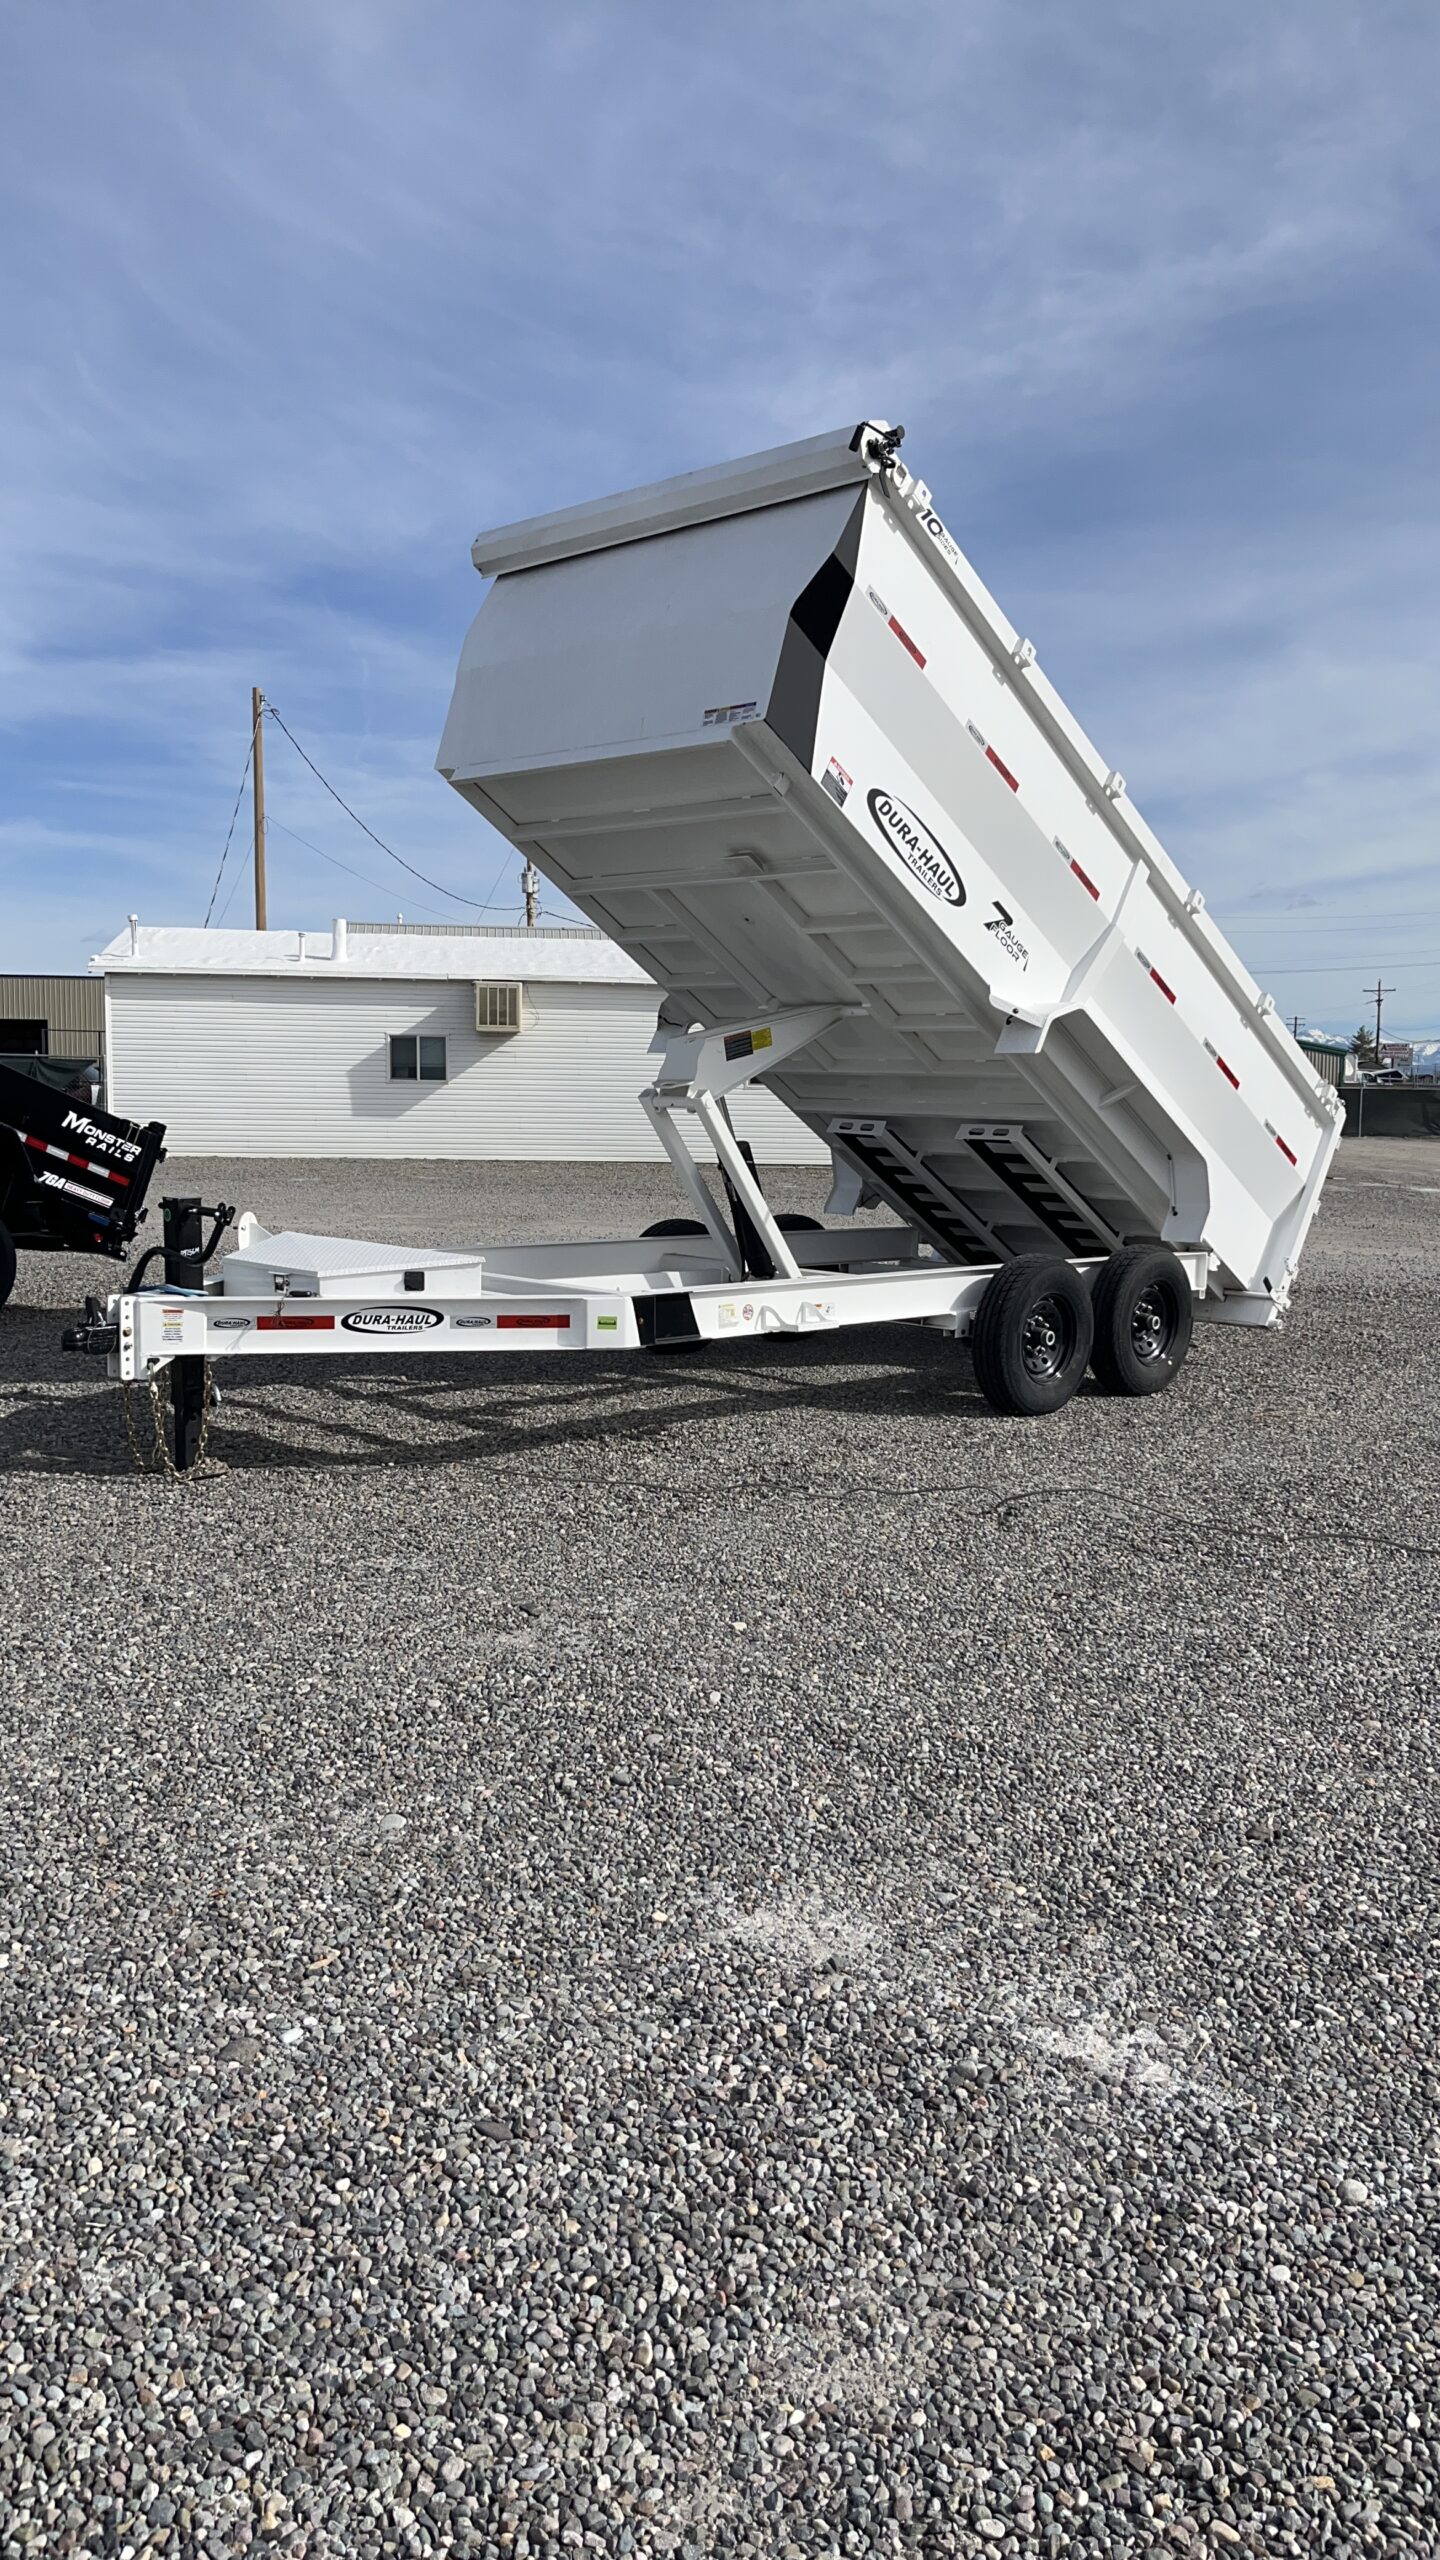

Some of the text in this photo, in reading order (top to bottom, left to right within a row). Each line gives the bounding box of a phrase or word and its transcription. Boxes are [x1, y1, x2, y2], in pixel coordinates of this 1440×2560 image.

[921, 508, 943, 536] 10
[877, 799, 955, 898] DURA-HAUL
[907, 851, 943, 897] TRAILERS
[983, 900, 1013, 931] 7
[989, 922, 1020, 962] FLOOR
[999, 920, 1029, 960] GAUGE
[61, 1110, 142, 1156] MONSTER
[85, 1136, 135, 1163] RAILS
[39, 1170, 67, 1190] 7GA
[352, 1314, 432, 1325] DURA-HAUL
